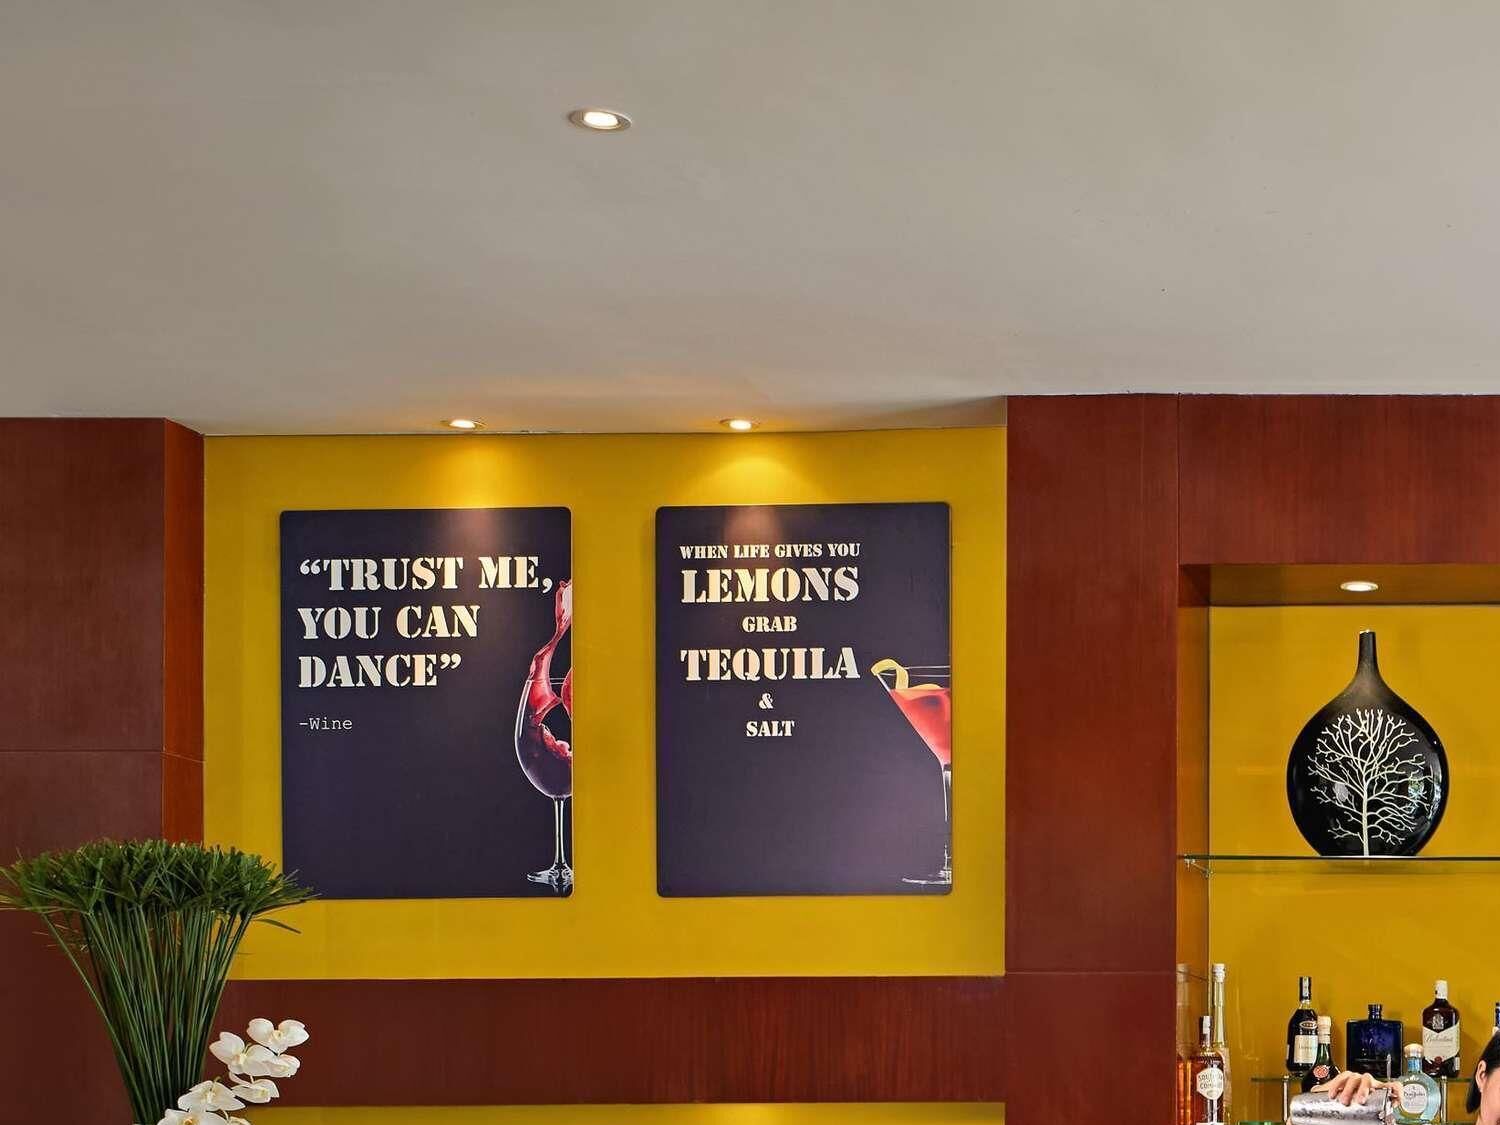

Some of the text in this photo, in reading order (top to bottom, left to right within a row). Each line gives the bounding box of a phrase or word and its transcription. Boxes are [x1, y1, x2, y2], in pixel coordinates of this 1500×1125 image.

[680, 543, 860, 559] WHEN LIFE GIVES YOU
[300, 556, 552, 593] “TRUST ME,
[681, 567, 859, 602] LEMONS
[298, 605, 480, 639] YOU CAN
[742, 616, 797, 632] GRAB
[299, 654, 461, 687] DANCE”
[681, 647, 860, 681] TEQUILA
[759, 693, 773, 709] &
[747, 720, 794, 736] SALT
